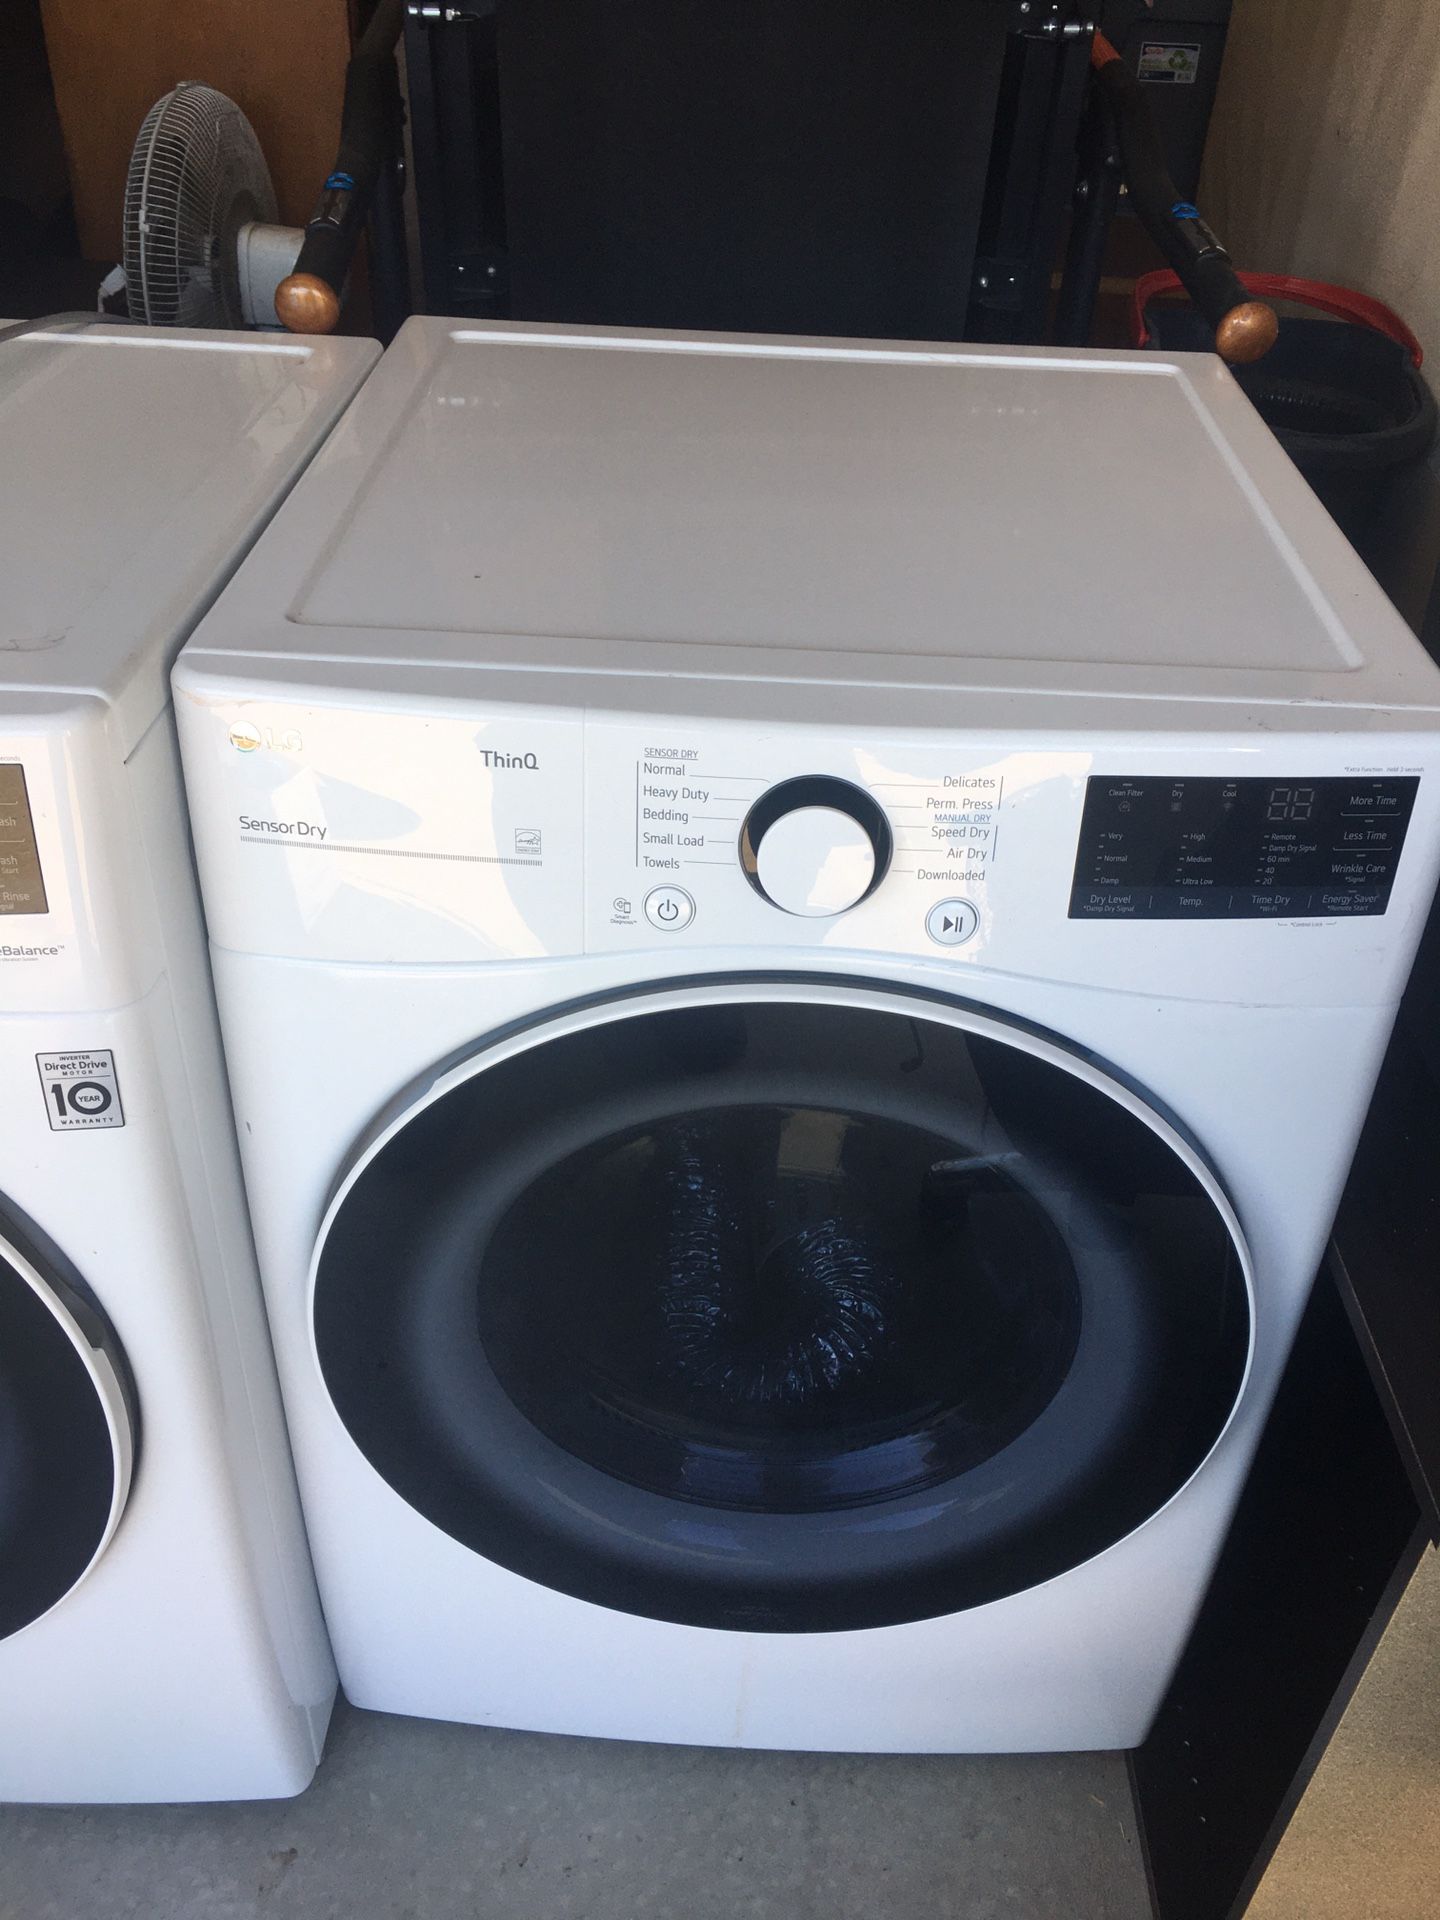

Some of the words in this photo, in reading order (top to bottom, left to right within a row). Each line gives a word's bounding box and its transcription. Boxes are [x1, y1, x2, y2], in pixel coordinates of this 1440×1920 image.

[644, 747, 679, 758] SENSOR
[681, 749, 699, 759] DRY
[479, 749, 540, 770] ThinQ
[643, 761, 686, 777] Normal
[943, 775, 996, 789] Delicates
[643, 785, 679, 802] Heavy
[682, 787, 710, 804] Duty
[1109, 789, 1126, 797] Clean
[1127, 789, 1144, 797] Filter
[1172, 790, 1183, 799] Dry
[1222, 790, 1237, 798] Cool
[926, 797, 959, 810] Perm.
[962, 798, 994, 811] Press
[1350, 796, 1373, 806] More
[1375, 795, 1397, 806] Time
[643, 807, 689, 825] Bedding
[934, 814, 971, 823] MANUAL
[973, 814, 992, 823] DRY
[643, 831, 674, 845] Small
[677, 834, 704, 847] Load
[931, 826, 967, 840] Speed
[969, 826, 990, 841] Dry
[1108, 832, 1123, 840] Very
[1190, 833, 1206, 841] High
[1343, 831, 1363, 841] Less
[1366, 830, 1388, 840] Time
[946, 848, 964, 859] Air
[967, 847, 987, 862] Dry
[1103, 855, 1128, 863] Normal
[1267, 855, 1277, 863] 60
[642, 855, 681, 870] Towels
[1331, 864, 1364, 873] Wrinkle
[1365, 863, 1386, 873] Care
[917, 869, 986, 881] Downloaded
[1264, 866, 1275, 874] 40
[1262, 877, 1272, 885] 20
[2, 891, 31, 901] Rinse
[1090, 894, 1106, 905] Dry
[1107, 894, 1132, 904] Level
[1179, 896, 1203, 907] Temp.
[1252, 895, 1273, 904] Time
[1274, 895, 1291, 906] Dry
[1322, 894, 1352, 906] Energy
[1354, 894, 1378, 903] Saver
[44, 1062, 77, 1071] Direct
[79, 1061, 108, 1069] Drive
[51, 1081, 112, 1116] 10
[61, 1117, 114, 1125] WARRANTY
